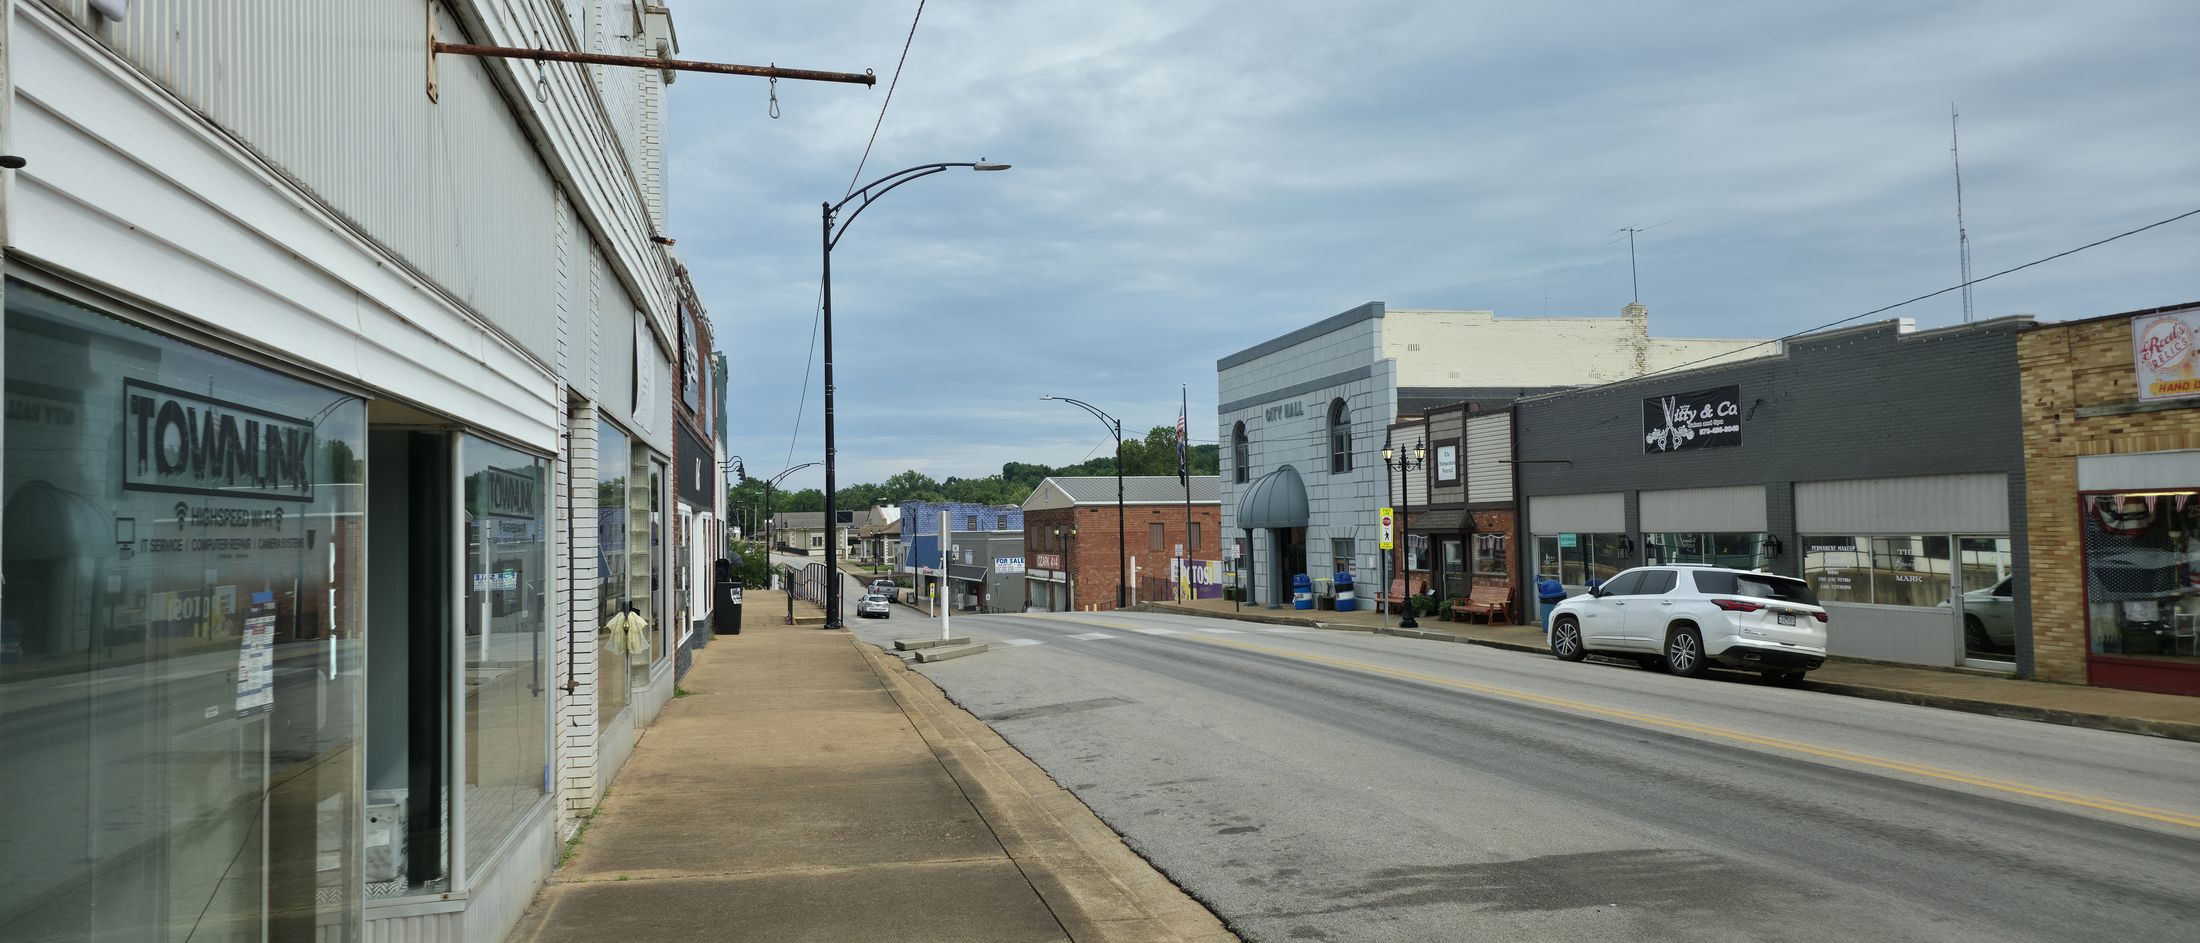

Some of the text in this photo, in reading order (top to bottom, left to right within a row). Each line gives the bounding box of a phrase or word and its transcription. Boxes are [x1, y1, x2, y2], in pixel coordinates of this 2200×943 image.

[2151, 338, 2188, 369] RELICS
[2159, 381, 2190, 393] HAND
[1265, 400, 1304, 422] CITY HALL
[1700, 403, 1714, 419] &
[130, 394, 311, 492] TOWNLINK
[191, 507, 249, 528] HIGHSPEED
[141, 538, 149, 553] IT
[151, 538, 183, 552] SERVICE
[191, 538, 229, 551] COMPUTER
[229, 538, 251, 551] REPAIR
[258, 538, 280, 550] CAMERA
[1896, 575, 1924, 583] MARK
